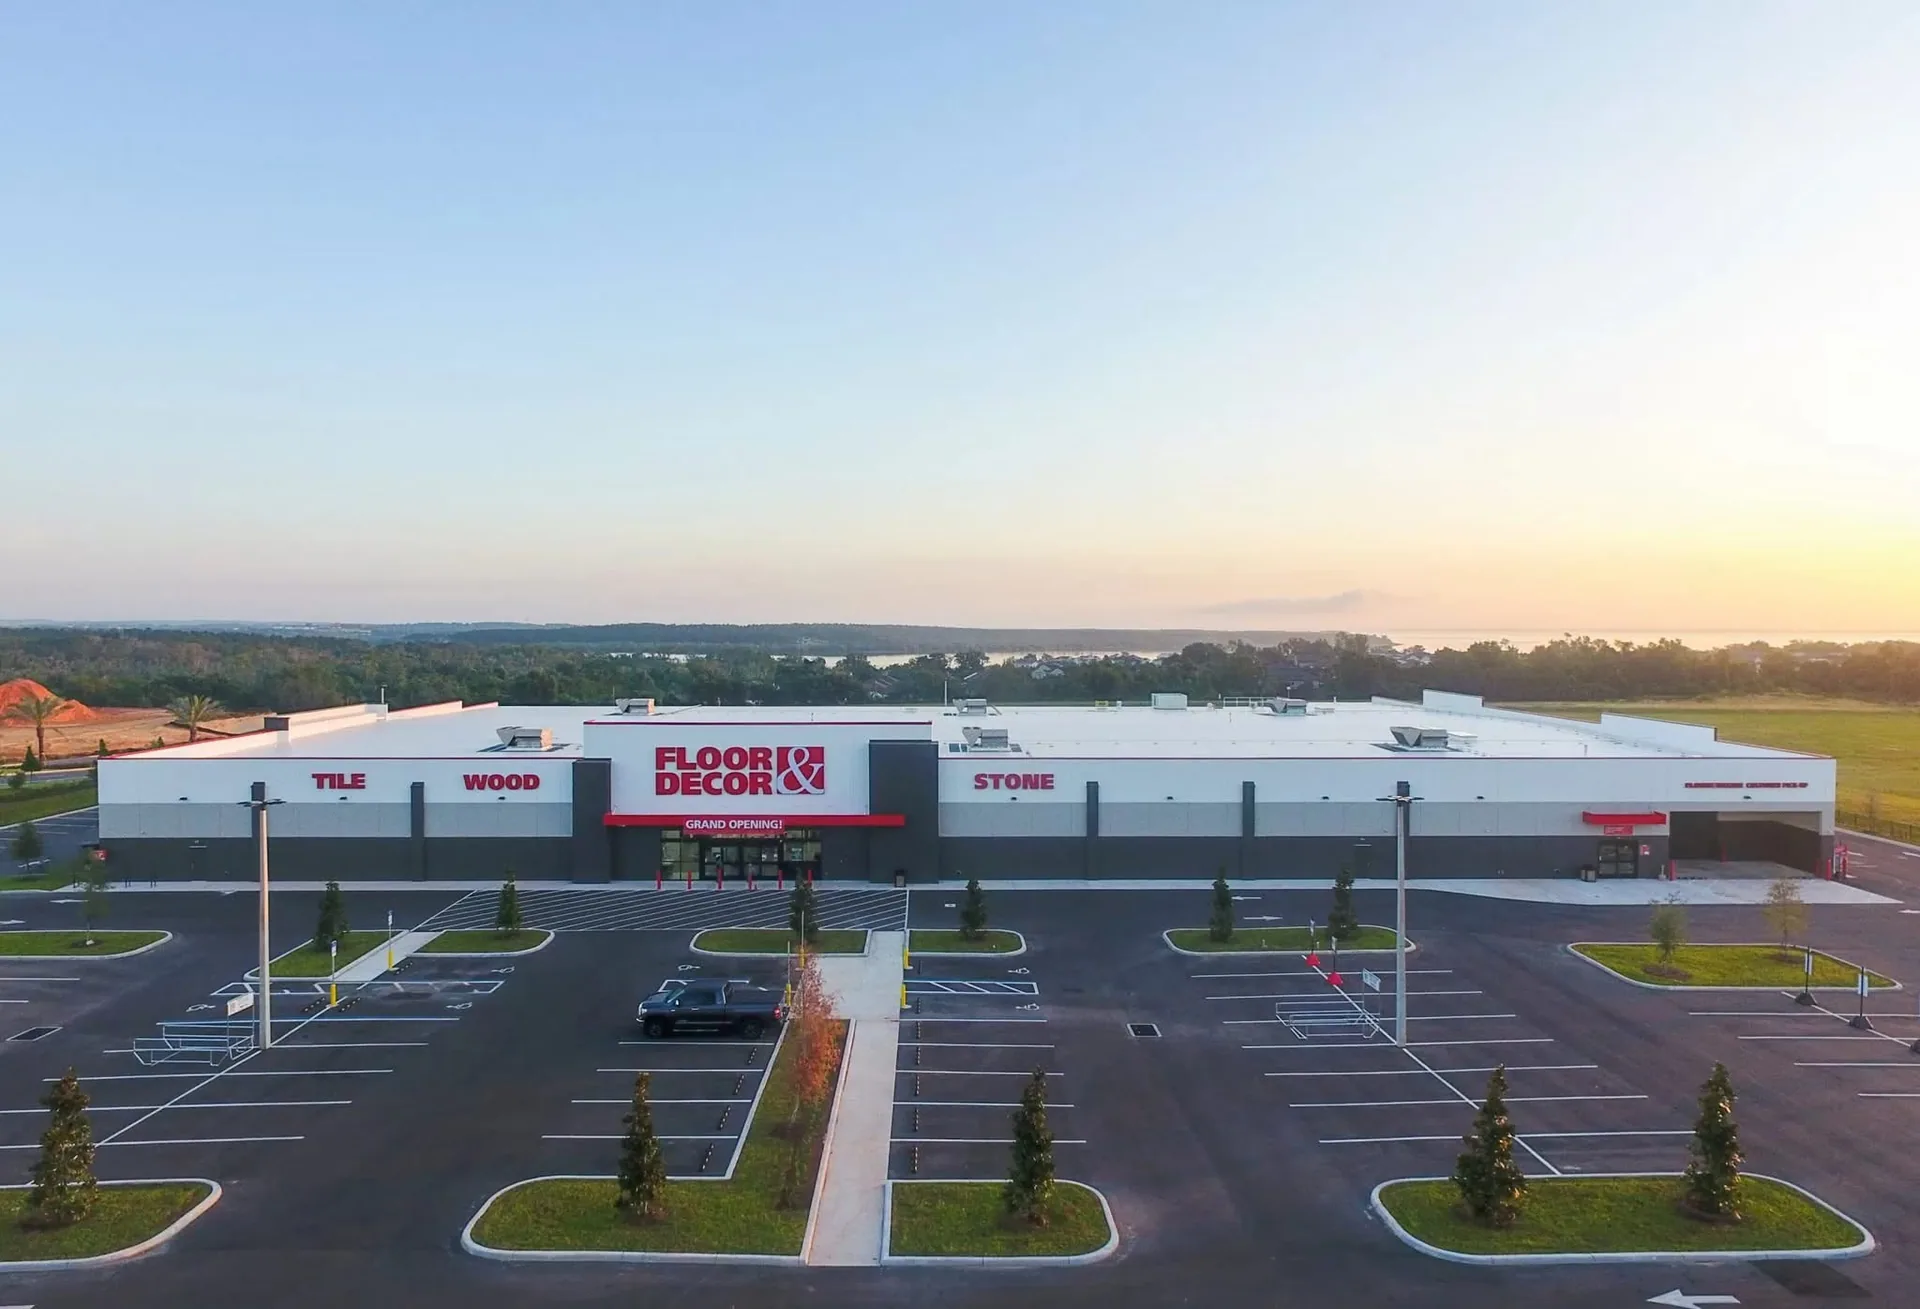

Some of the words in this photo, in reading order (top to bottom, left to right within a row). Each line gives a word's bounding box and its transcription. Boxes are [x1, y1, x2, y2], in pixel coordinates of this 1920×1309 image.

[655, 746, 773, 770] FLOOR
[777, 746, 825, 795] &
[312, 773, 366, 789] TILE
[463, 774, 540, 790] WOOD
[655, 772, 773, 795] DECOR
[974, 773, 1054, 790] STONE
[686, 819, 726, 830] GRAND
[728, 819, 783, 830] OPENING!
